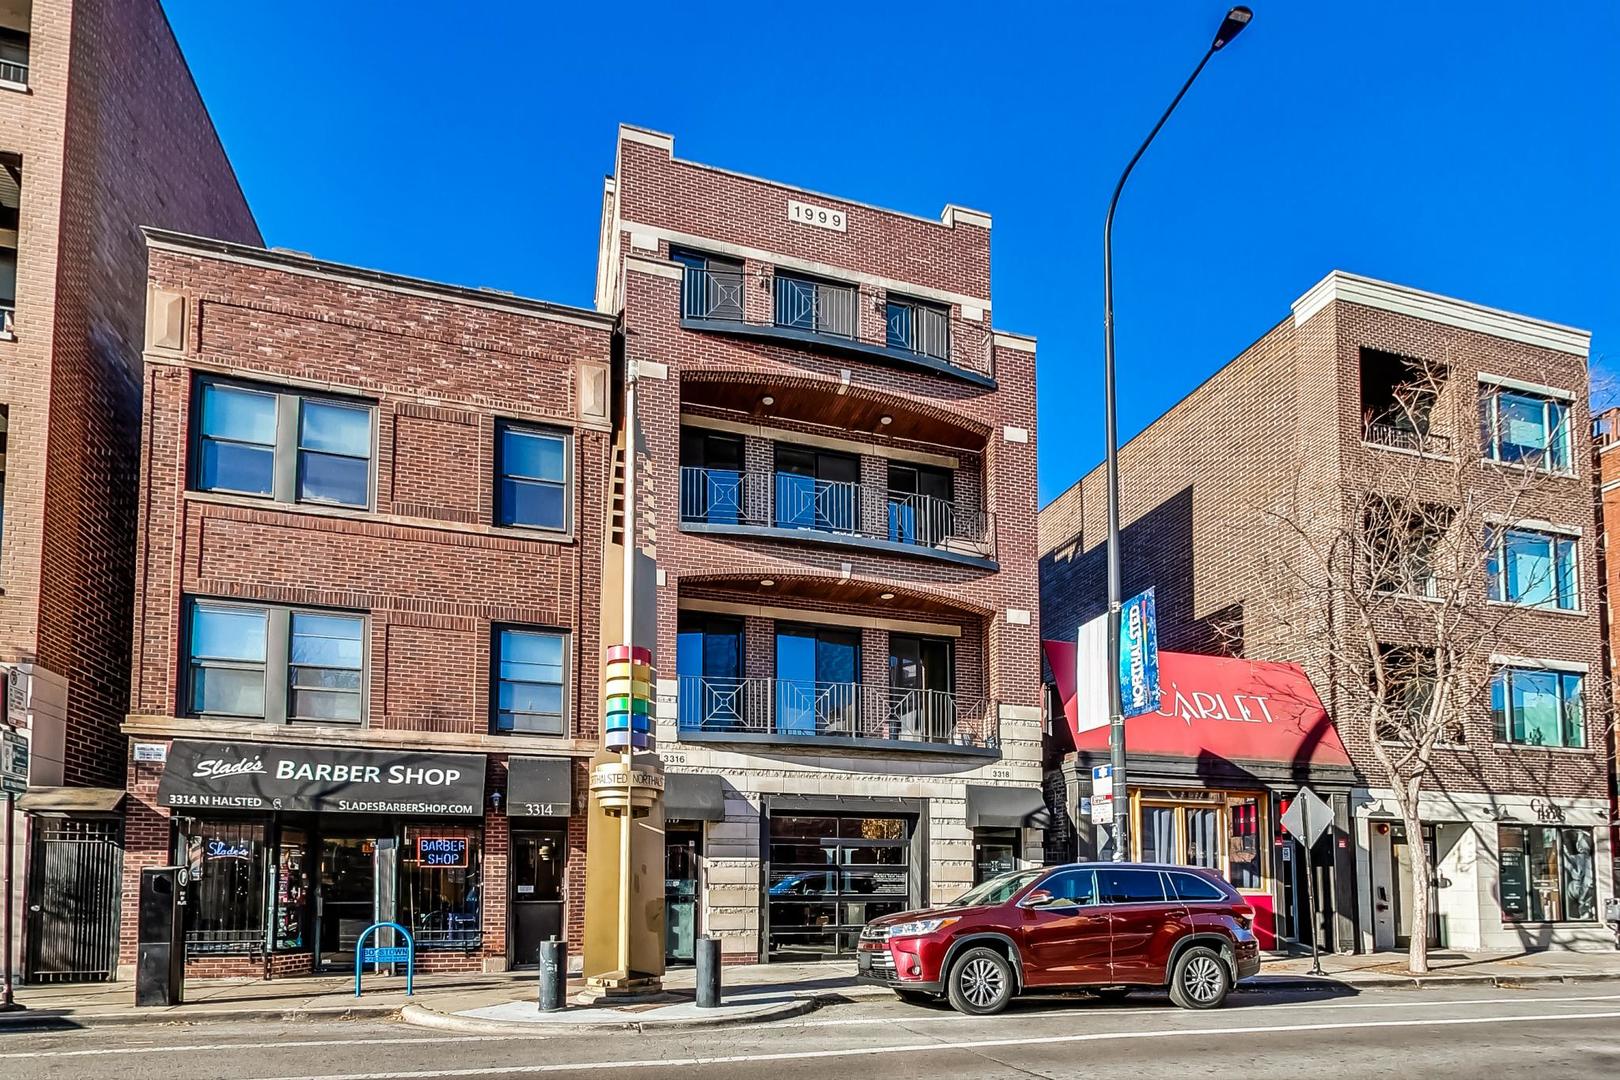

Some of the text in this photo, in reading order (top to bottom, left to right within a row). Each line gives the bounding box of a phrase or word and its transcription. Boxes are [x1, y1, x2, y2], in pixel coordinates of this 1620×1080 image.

[794, 205, 841, 227] 1999
[1130, 605, 1145, 708] NORTHALSTED
[1156, 682, 1272, 726] CARLET
[663, 754, 685, 763] 3316
[192, 755, 461, 786] Slade's BARBER SHOP
[992, 769, 1010, 778] 3318
[169, 794, 262, 807] 3314 N HALSTED
[525, 803, 553, 816] 3314
[420, 839, 465, 852] BARBER
[427, 853, 460, 865] SHOP
